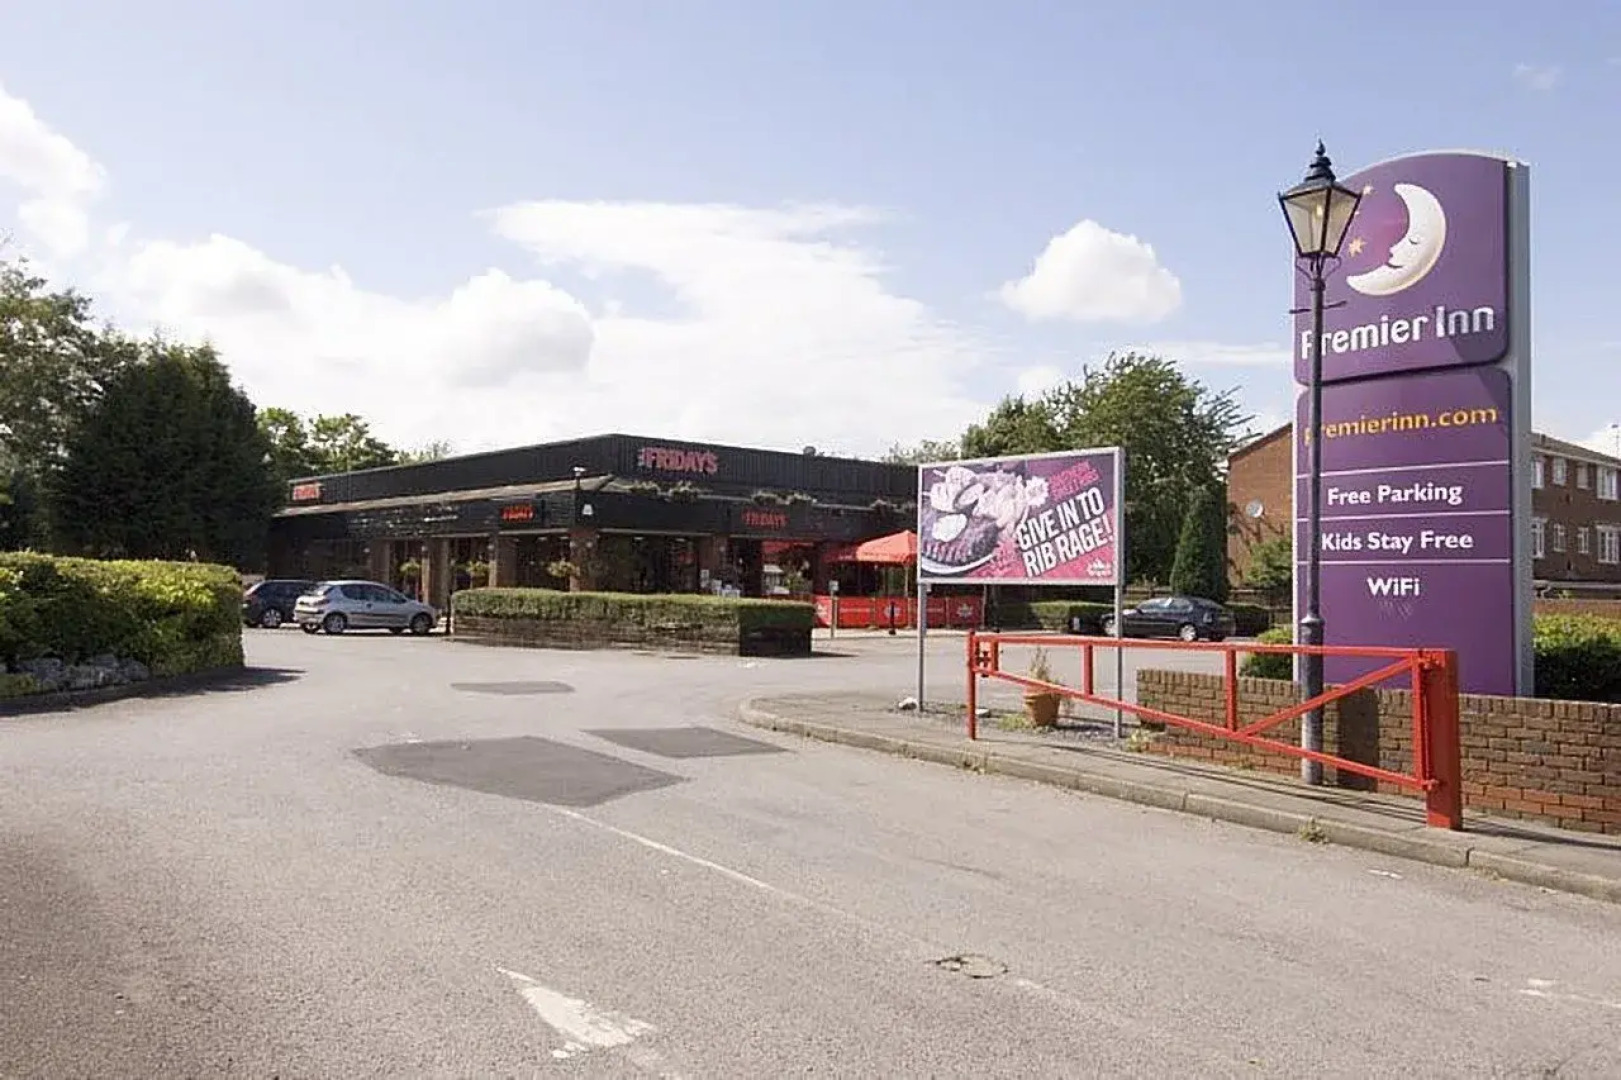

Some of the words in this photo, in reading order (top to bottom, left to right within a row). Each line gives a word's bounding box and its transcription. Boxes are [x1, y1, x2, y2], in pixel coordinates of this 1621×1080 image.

[1301, 315, 1429, 359] Premier
[1435, 306, 1495, 338] Inn
[1304, 407, 1498, 446] pemierinn.com
[1327, 487, 1371, 505] Free
[1377, 482, 1463, 505] Parking
[1016, 508, 1060, 550] GIVE
[1056, 498, 1080, 532] IN
[1075, 486, 1105, 520] TO
[1022, 541, 1057, 577] RIB
[1054, 513, 1114, 563] RAGE!
[1321, 533, 1362, 551] Kids
[1367, 531, 1414, 554] Stay
[1420, 530, 1474, 549] Free
[1367, 577, 1421, 596] WiFi
